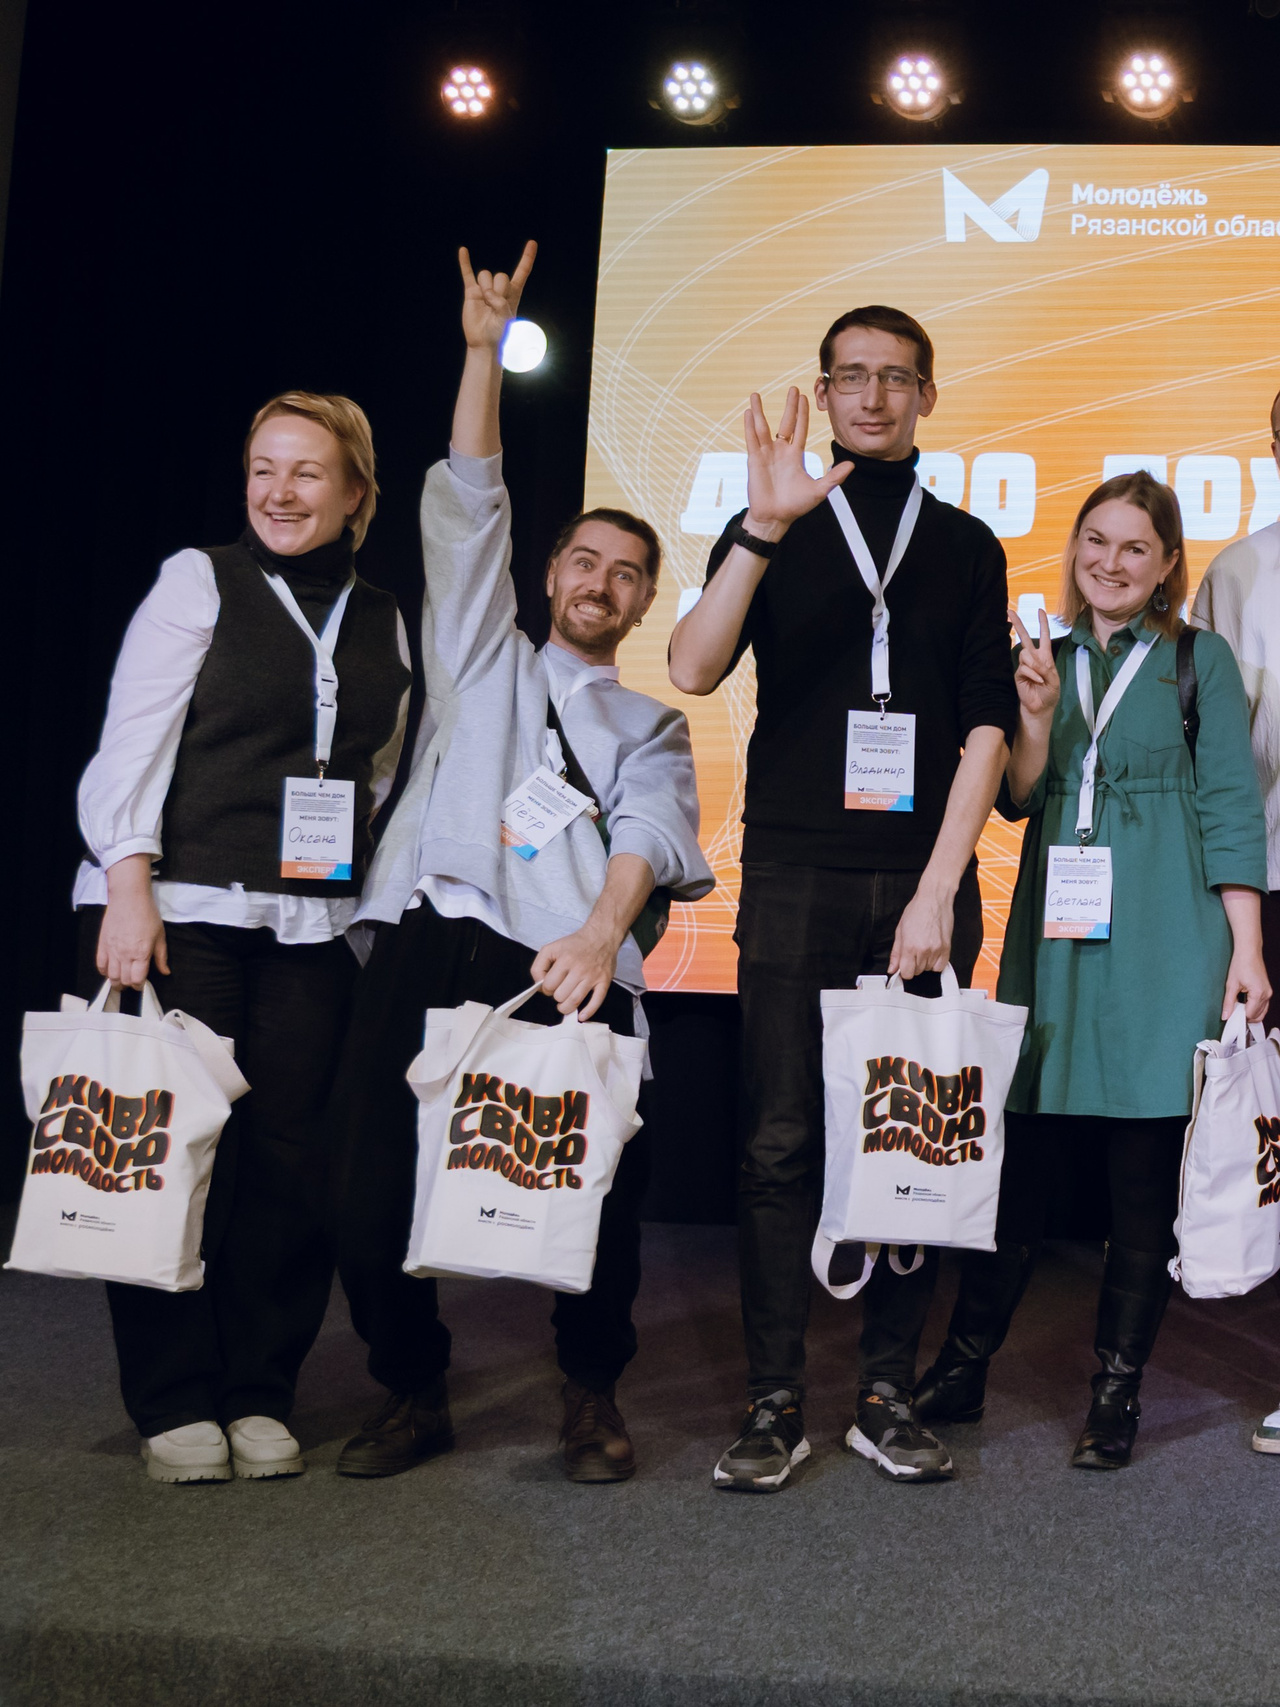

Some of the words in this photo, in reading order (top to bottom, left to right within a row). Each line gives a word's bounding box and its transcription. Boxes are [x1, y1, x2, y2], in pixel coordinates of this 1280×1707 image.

[1072, 182, 1208, 209] Молодёжь
[1071, 212, 1207, 238] Рязанской
[853, 723, 878, 731] БОЛЬШЕ
[848, 760, 906, 778] Владимир
[291, 790, 317, 798] БОЛЬШЕ
[859, 796, 898, 805] ЭКСПЕРТ
[288, 826, 337, 844] Оксана
[297, 865, 336, 874] ЭКСПЕРТ
[1048, 889, 1102, 907] Светлана
[1058, 925, 1095, 933] ЭКСПЕРТ
[864, 1055, 984, 1116] ЖИВИ
[40, 1074, 176, 1140] ЖИВИ
[453, 1072, 591, 1138] ЖИВИ
[862, 1086, 987, 1148] СВОЮ
[33, 1106, 172, 1174] СВОЮ
[449, 1103, 589, 1171] СВОЮ
[862, 1125, 985, 1166] МОЛОДОСТЬ
[31, 1147, 165, 1194] МОЛОДОСТЬ
[446, 1142, 584, 1191] МОЛОДОСТЬ
